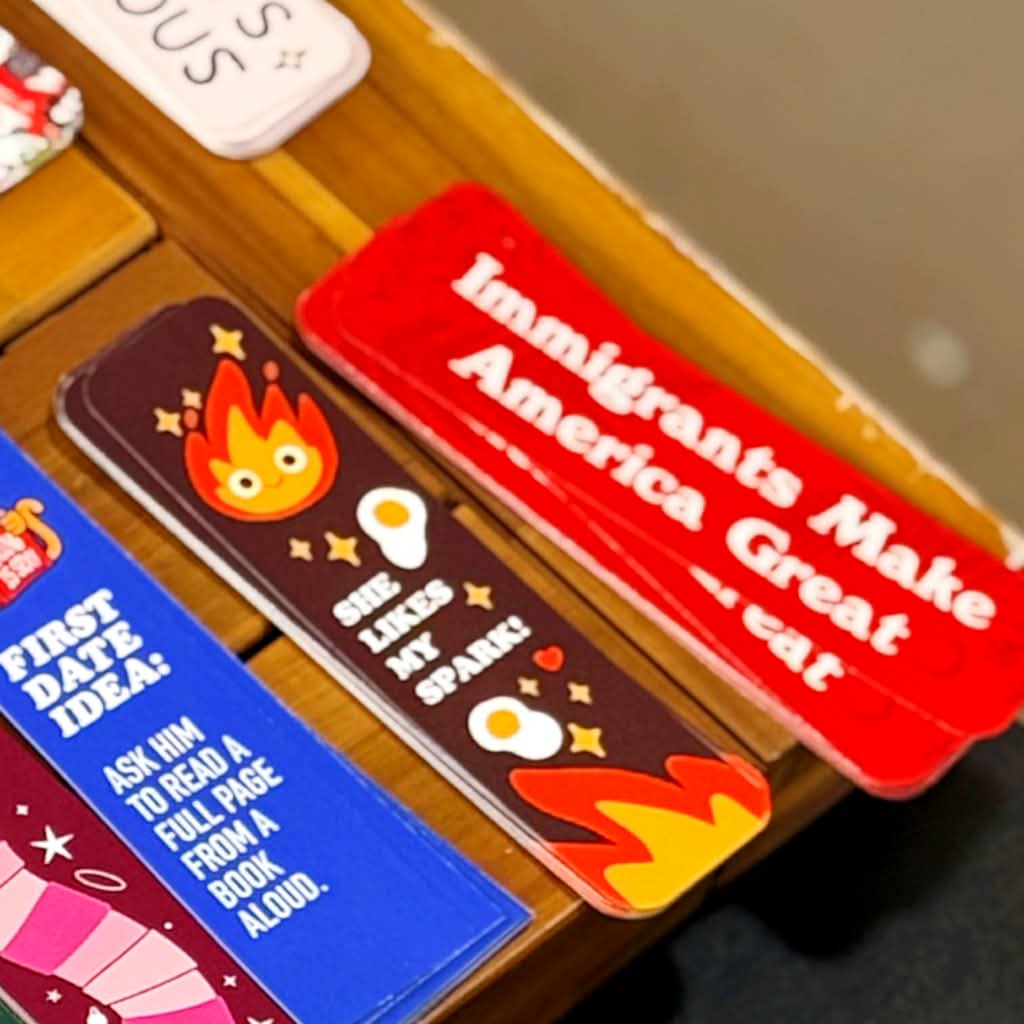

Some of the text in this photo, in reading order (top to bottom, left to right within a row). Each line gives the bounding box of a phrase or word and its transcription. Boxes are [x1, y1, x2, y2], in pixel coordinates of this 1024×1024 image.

[452, 252, 997, 630] Immigrants Make
[448, 344, 911, 655] America Great
[332, 571, 402, 627] SHE
[357, 578, 454, 654] LIKES
[21, 621, 144, 711] DATE
[48, 652, 172, 738] IDEA:
[384, 631, 440, 681] MY
[415, 615, 532, 706] SPARK!
[102, 715, 206, 796] ASK HIM
[125, 734, 253, 823] TO READ A
[153, 756, 284, 852] FULL PAGE
[180, 808, 280, 882] FROM A
[207, 851, 286, 910] BOOK
[236, 870, 330, 940] ALOUD.
